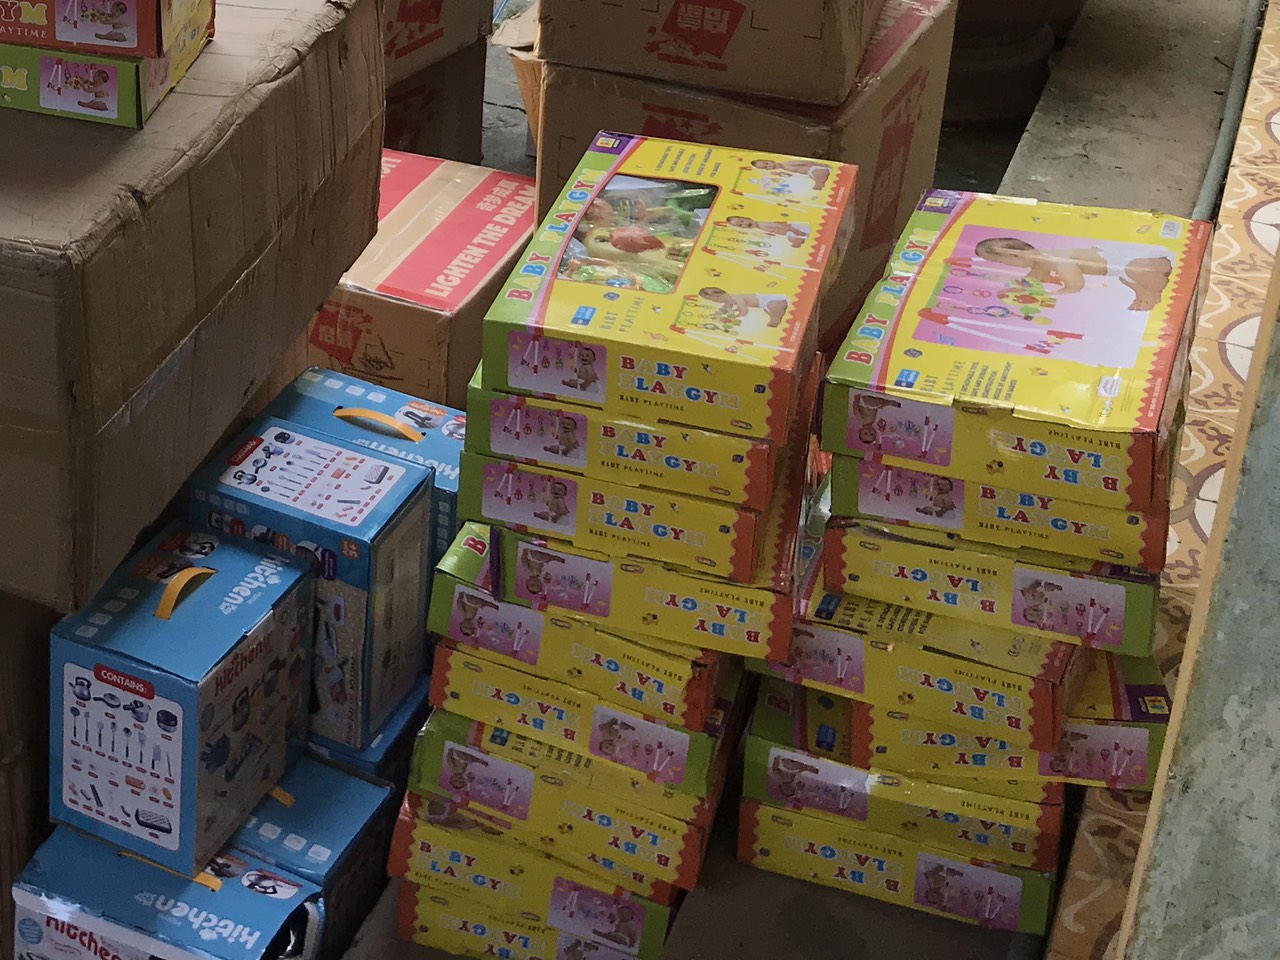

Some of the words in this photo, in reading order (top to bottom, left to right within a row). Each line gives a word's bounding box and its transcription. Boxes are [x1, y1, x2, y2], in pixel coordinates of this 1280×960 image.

[424, 245, 489, 298] LIGHTEN
[472, 221, 511, 250] THE
[493, 185, 538, 227] DREAM
[505, 252, 551, 302] BABY
[540, 168, 607, 243] PLAYGYM
[844, 313, 889, 366] BABY
[874, 228, 940, 307] PLAYGYM
[619, 296, 645, 333] PLAYTIME
[621, 356, 688, 379] BABY
[619, 373, 740, 410] PLAYGYM
[644, 400, 685, 412] PLAYTIME
[601, 425, 667, 448] BABY
[989, 429, 1122, 473] PLAYGYM
[1048, 429, 1093, 444] PLAYTIME
[600, 441, 719, 479] PLAYGYM
[624, 465, 665, 478] PLAYTIME
[1043, 465, 1120, 492] BABY
[591, 492, 655, 517] BABY
[980, 486, 1054, 511] BABY
[589, 508, 705, 547] PLAYGYM
[978, 500, 1112, 540] PLAYGYM
[611, 534, 651, 547] PLAYTIME
[872, 560, 999, 597] PLAYGYM
[644, 587, 764, 624] PLAYGYM
[926, 588, 997, 614] BABY
[694, 618, 761, 644] BABY
[100, 668, 147, 694] CONTAINS:
[572, 643, 681, 700] PLAYGYM
[473, 680, 581, 729] PLAYGYM
[616, 681, 677, 716] BABY
[898, 665, 1025, 713] PLAYGYM
[517, 712, 577, 742] BABY
[951, 701, 1023, 730] BABY
[954, 752, 1024, 769] BABY
[563, 800, 675, 852] PLAYGYM
[958, 829, 1027, 853] BABY
[419, 840, 476, 868] BABY
[587, 852, 647, 884] BABY
[607, 836, 671, 868] BABY
[783, 835, 904, 876] PLAYGYM
[415, 856, 520, 899] PLAYGYM
[833, 865, 900, 892] BABY
